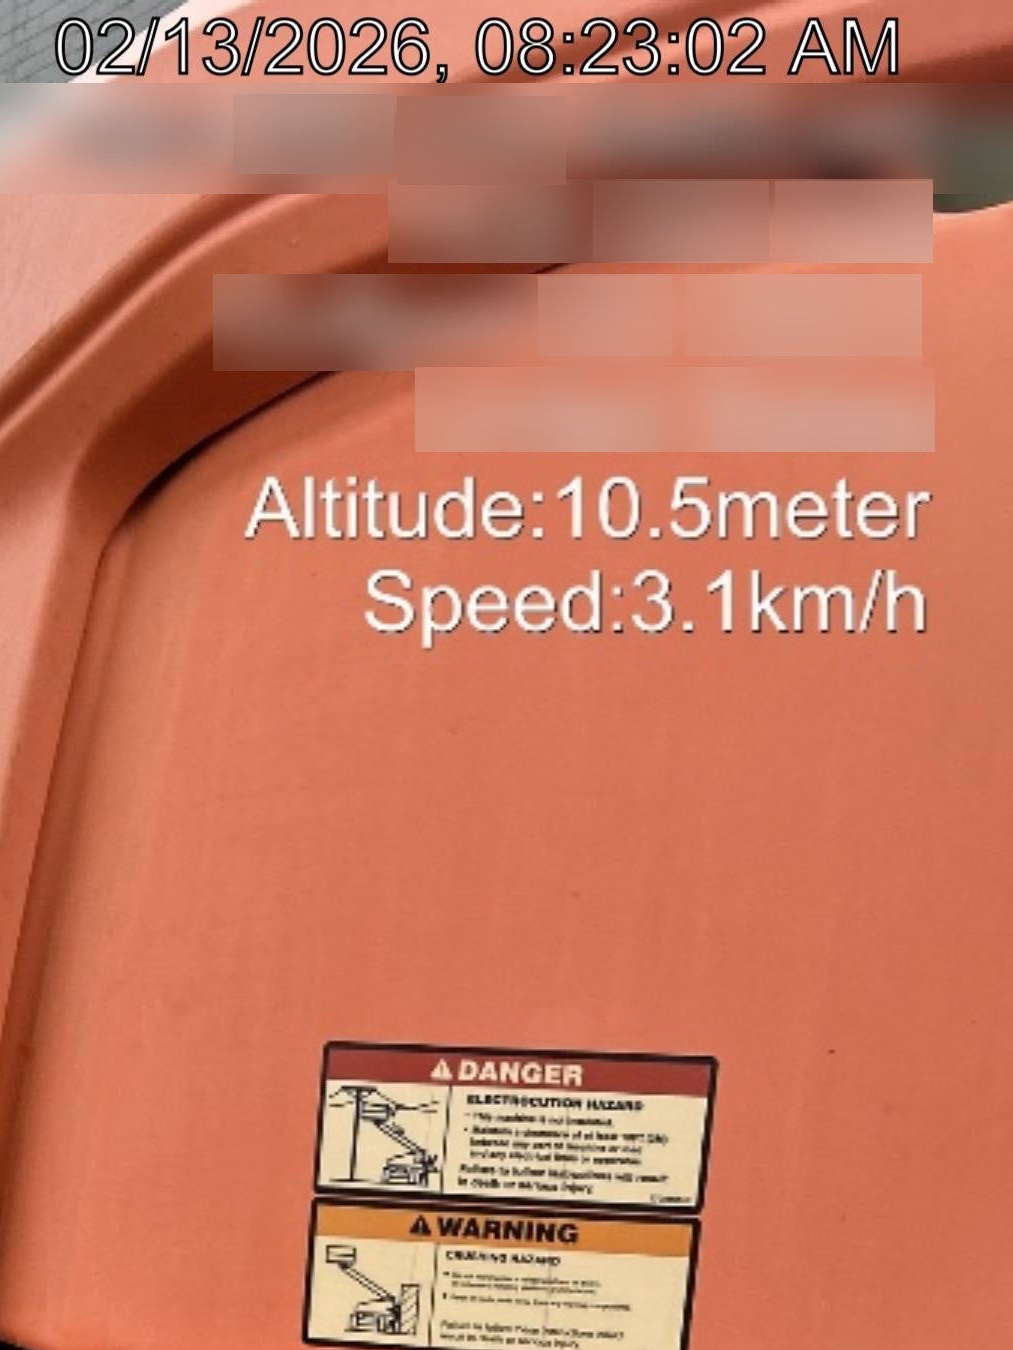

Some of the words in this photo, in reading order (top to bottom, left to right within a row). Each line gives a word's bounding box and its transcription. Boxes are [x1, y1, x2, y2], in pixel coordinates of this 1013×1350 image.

[457, 1059, 583, 1087] DANGER
[466, 1093, 582, 1110] ELECTROCUTION
[586, 1098, 645, 1112] HAZARD
[437, 1216, 580, 1244] WARNING
